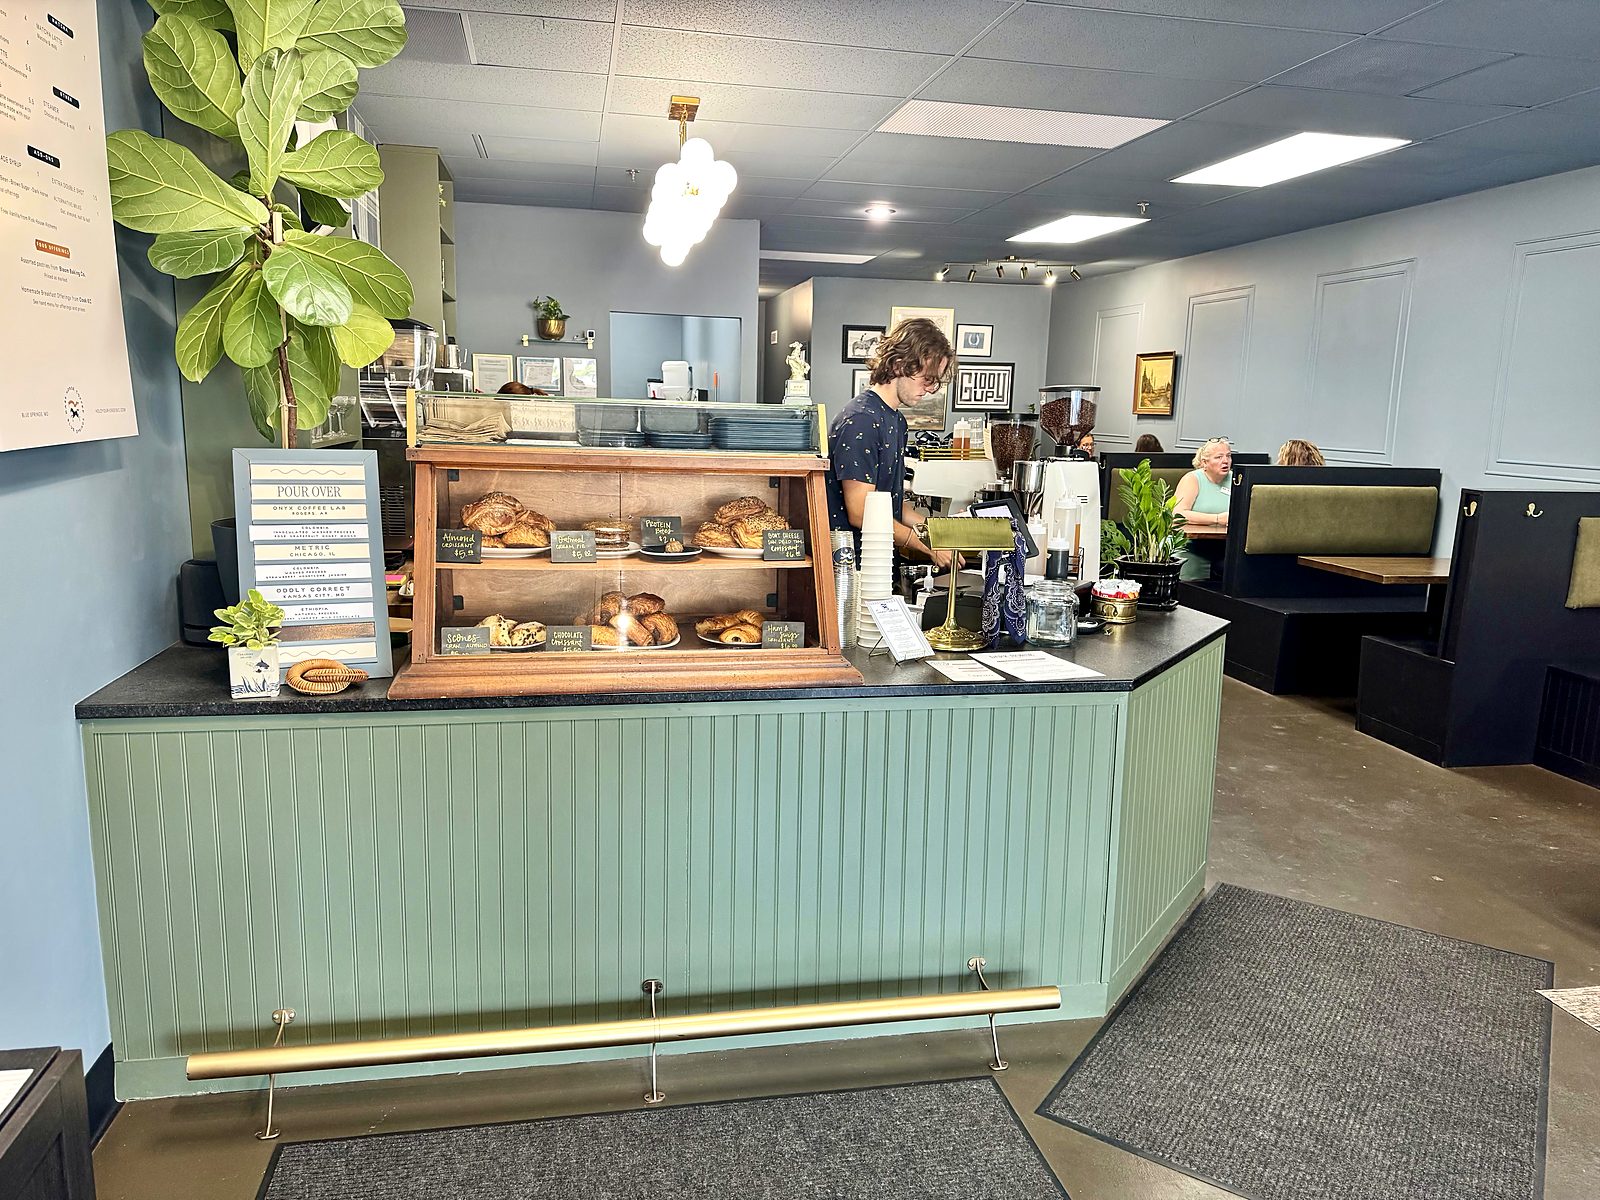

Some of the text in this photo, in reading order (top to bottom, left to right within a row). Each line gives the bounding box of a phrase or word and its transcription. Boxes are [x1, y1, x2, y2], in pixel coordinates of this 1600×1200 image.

[36, 240, 47, 249] FOOD
[20, 256, 36, 266] Assorted
[21, 286, 41, 296] Homemade
[277, 486, 342, 498] POUR OVER
[645, 520, 672, 529] PROTEIN
[442, 532, 476, 543] Almond
[557, 535, 586, 544] Oatmeal
[783, 532, 800, 540] CHEESE
[768, 624, 782, 633] Ham
